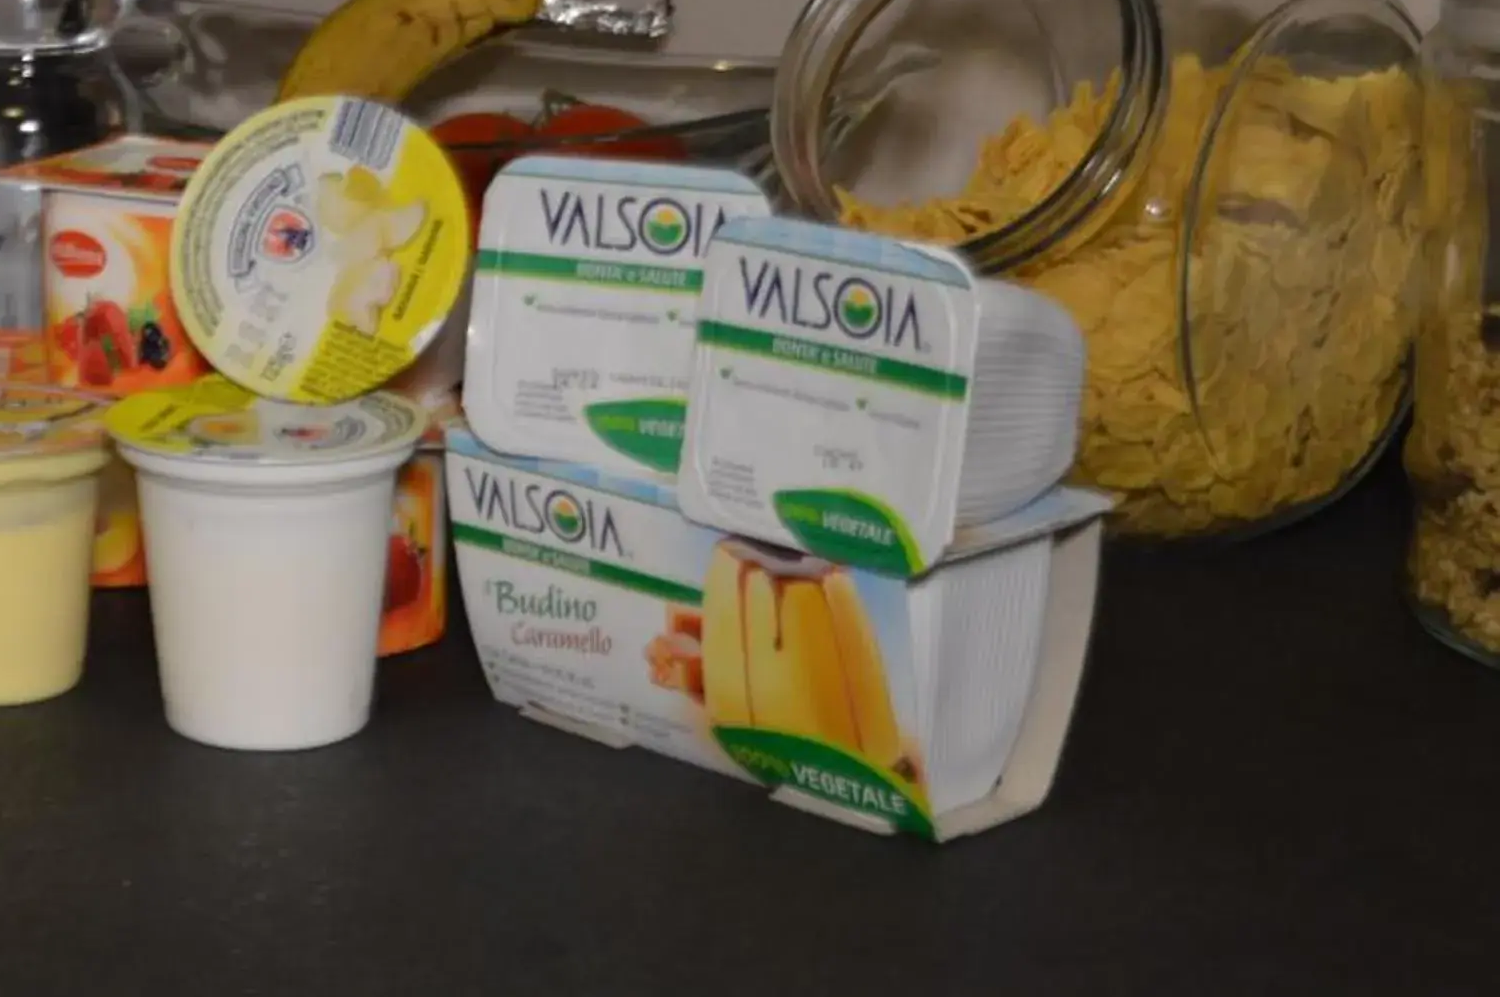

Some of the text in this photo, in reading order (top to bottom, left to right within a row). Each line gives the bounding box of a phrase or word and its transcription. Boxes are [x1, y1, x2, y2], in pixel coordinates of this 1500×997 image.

[739, 255, 922, 352] VALSOIA
[464, 465, 625, 558] VALSOIA
[493, 579, 598, 623] Budino
[790, 760, 908, 816] VEGETALE
